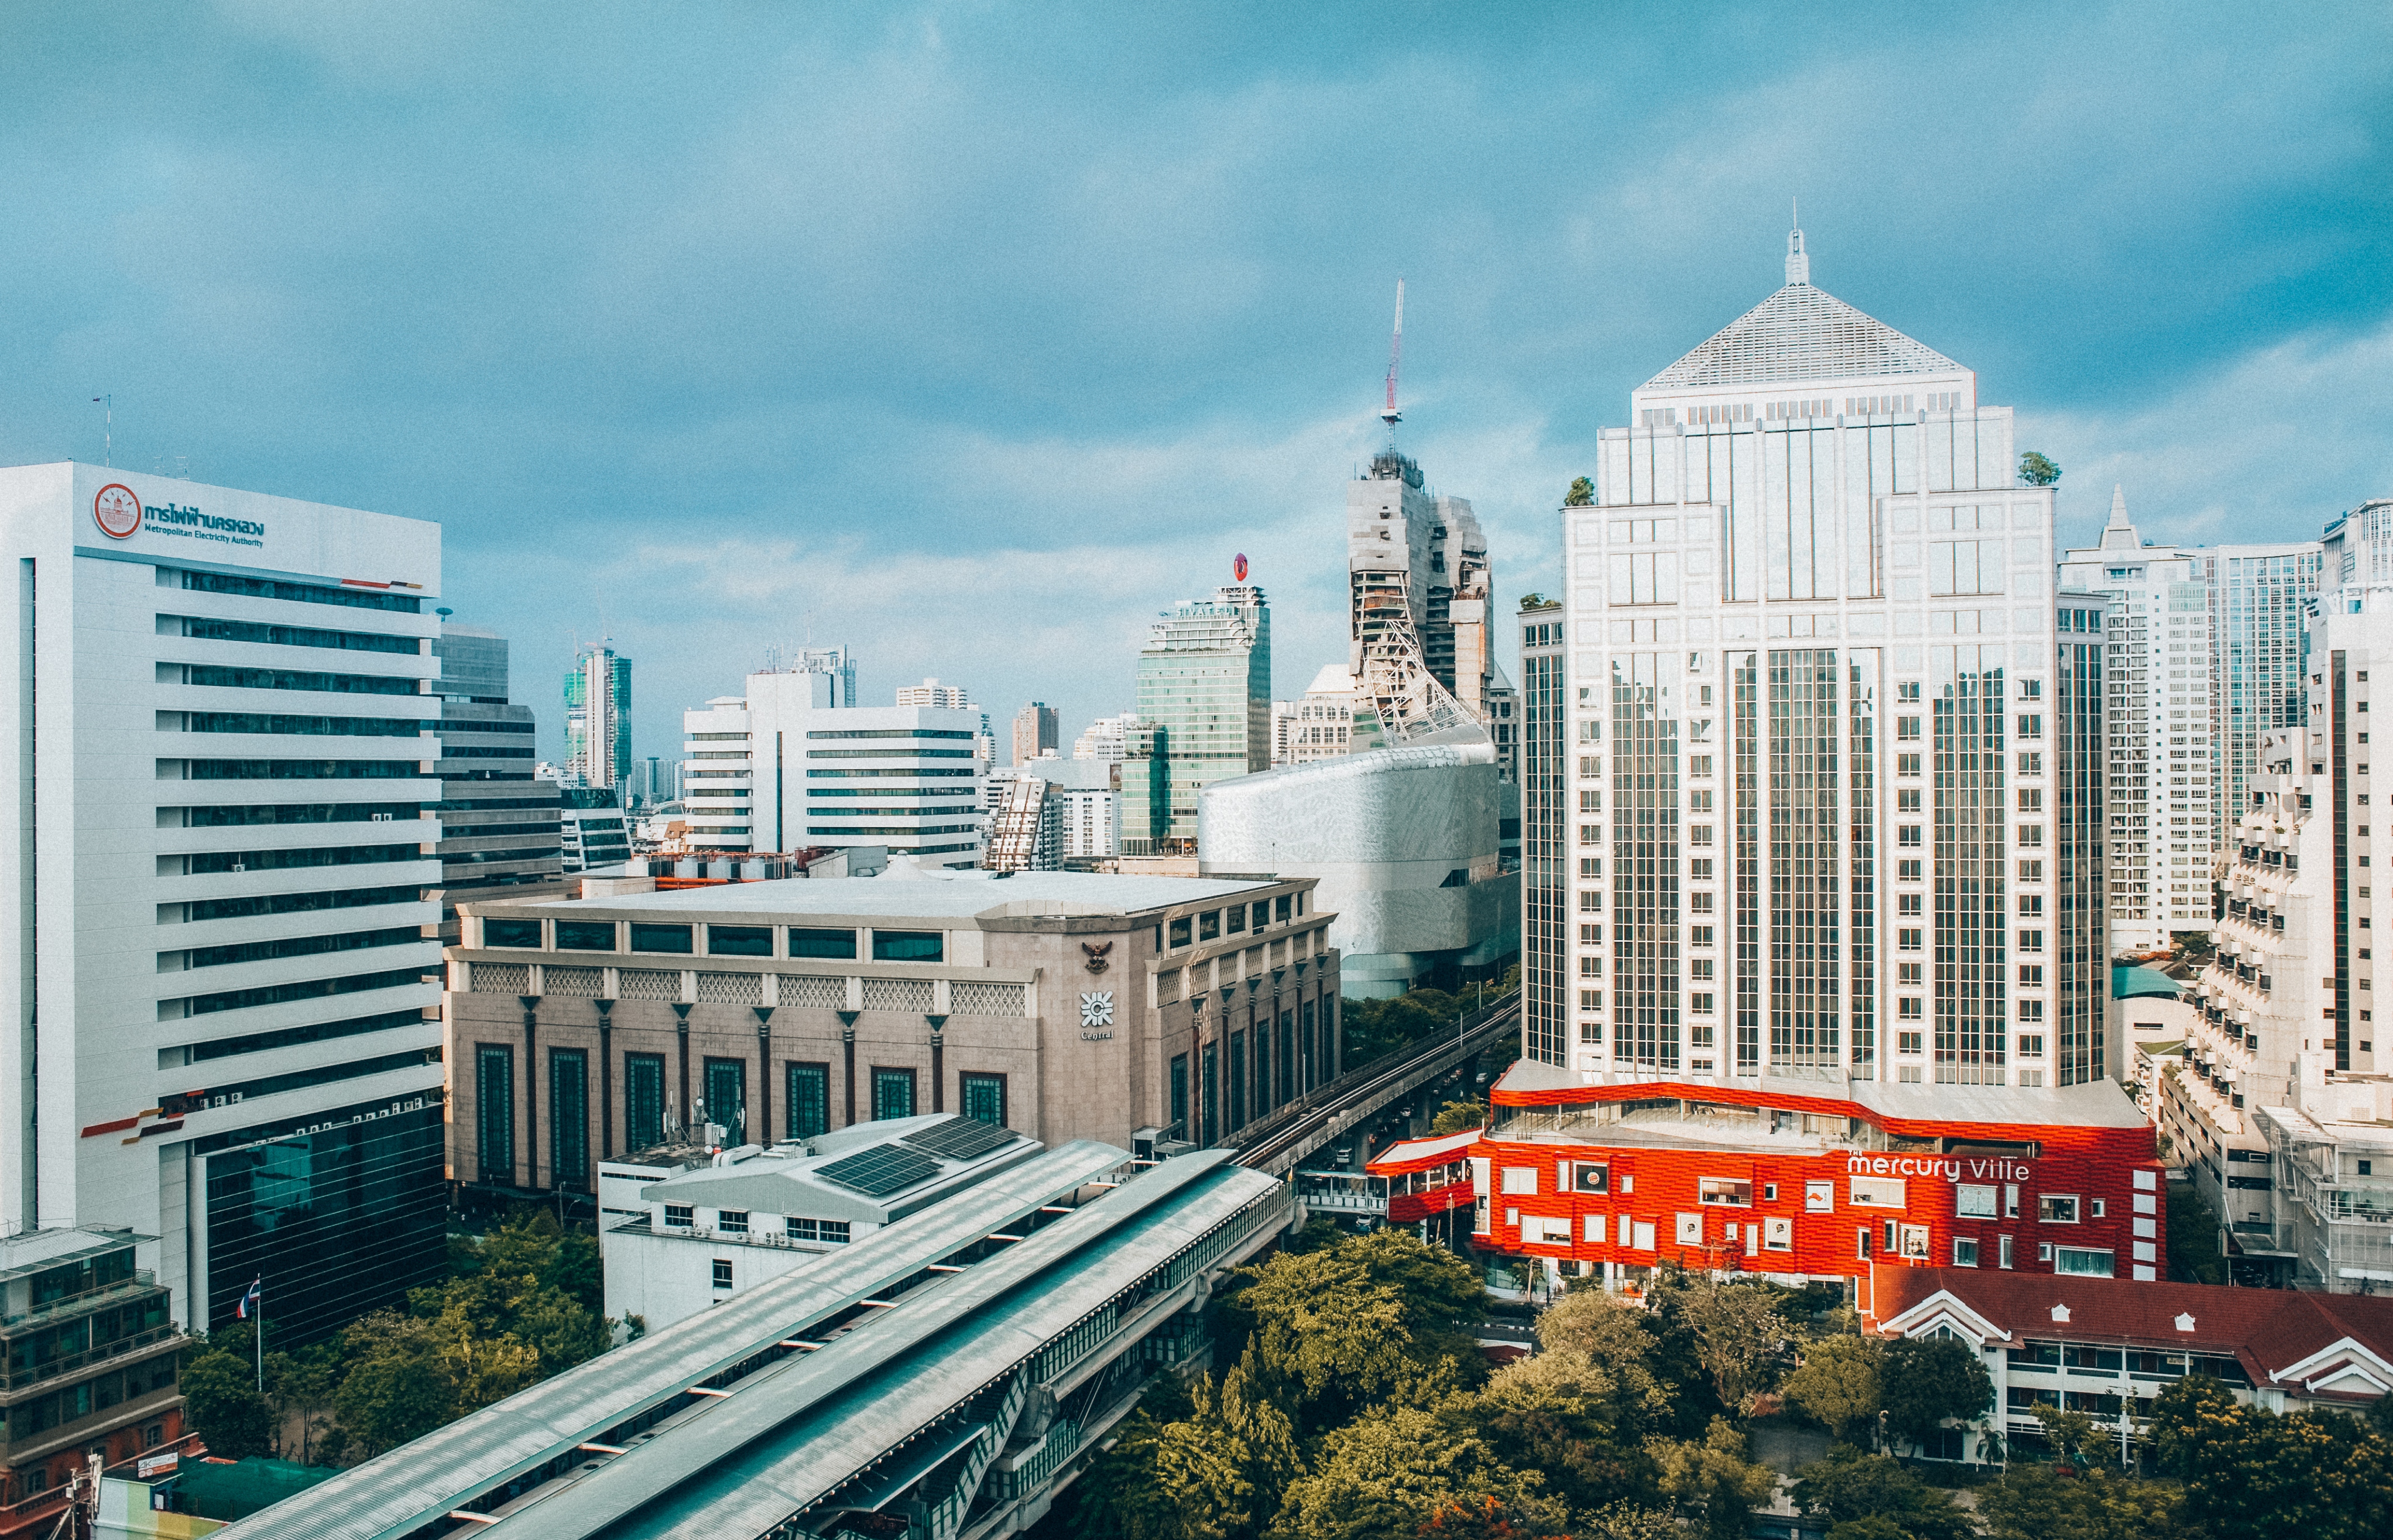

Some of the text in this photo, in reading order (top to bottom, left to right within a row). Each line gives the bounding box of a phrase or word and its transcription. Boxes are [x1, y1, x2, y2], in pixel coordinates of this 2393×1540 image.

[145, 503, 265, 536] การไฟฟ้านครหลวง
[145, 523, 263, 549] Metropolitan Electricity Authority
[1081, 1030, 1114, 1041] Central
[1847, 1156, 2029, 1182] mercury Ville
